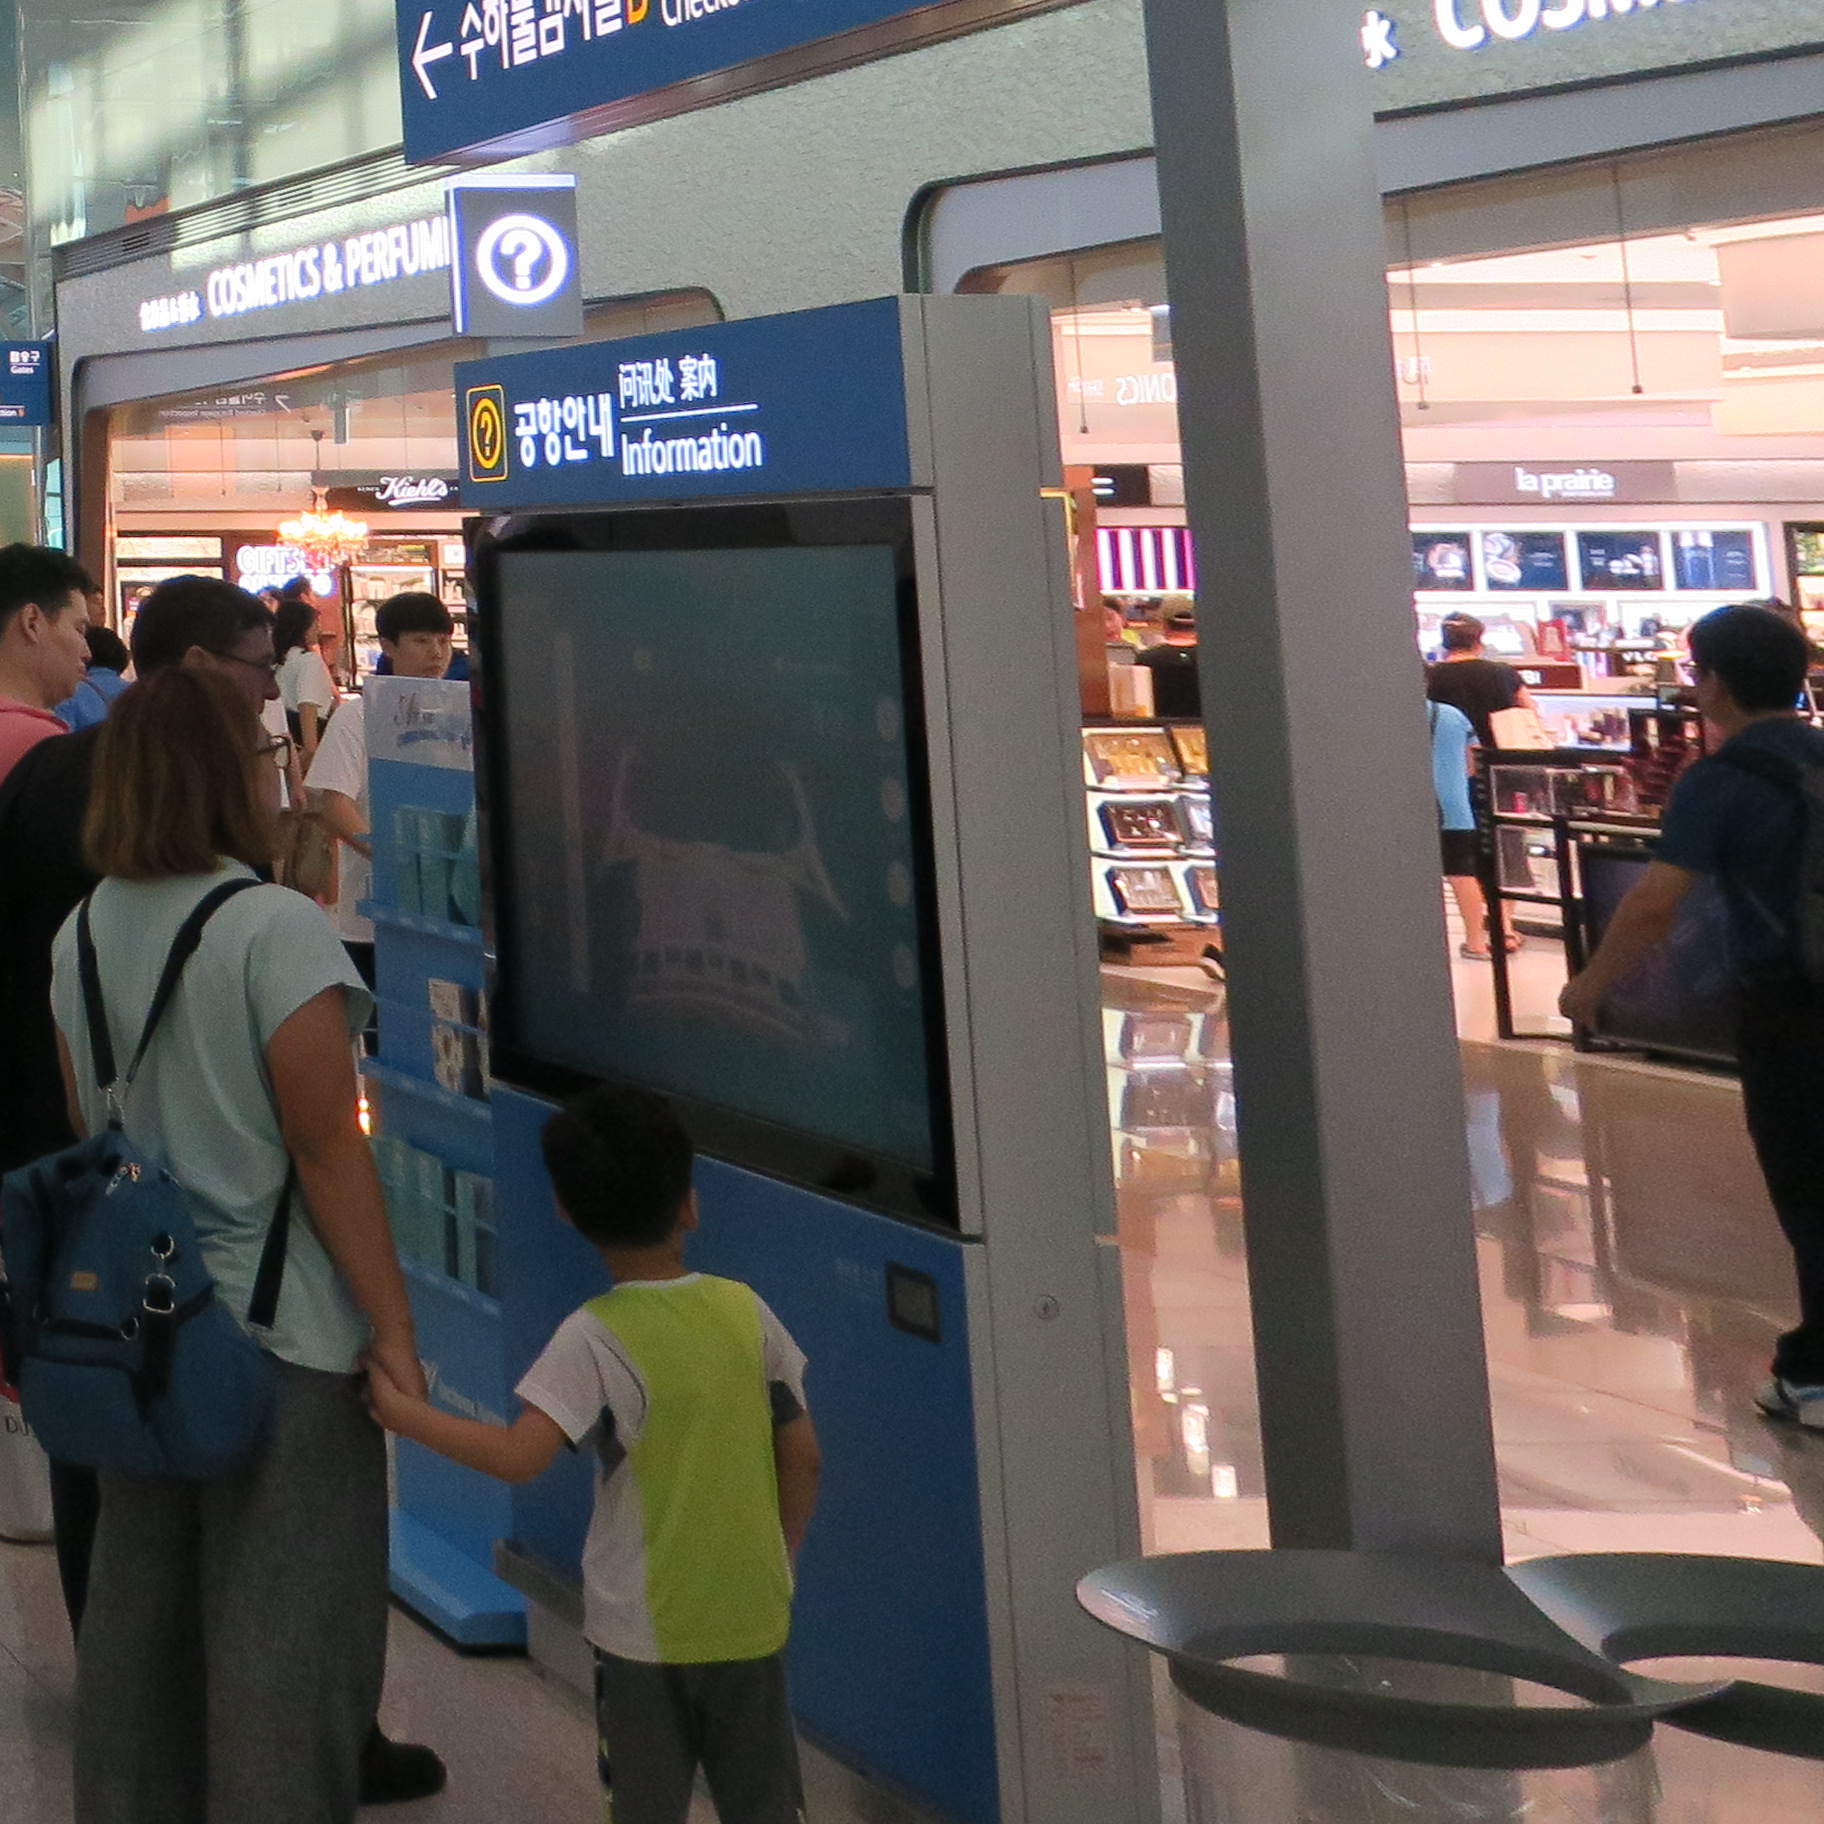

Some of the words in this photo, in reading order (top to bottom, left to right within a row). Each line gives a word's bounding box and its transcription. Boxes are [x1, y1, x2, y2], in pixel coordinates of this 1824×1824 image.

[207, 244, 322, 317] COSMETICS
[322, 240, 344, 293] &
[344, 215, 452, 287] PERFUM
[10, 365, 34, 375] Gates
[618, 357, 674, 409] 问讯处
[678, 352, 718, 402] 案内
[513, 392, 614, 468] 공항안내
[620, 422, 763, 476] Information
[375, 475, 449, 500] Kiehl's
[1514, 466, 1539, 492] la
[1540, 467, 1615, 498] prairie
